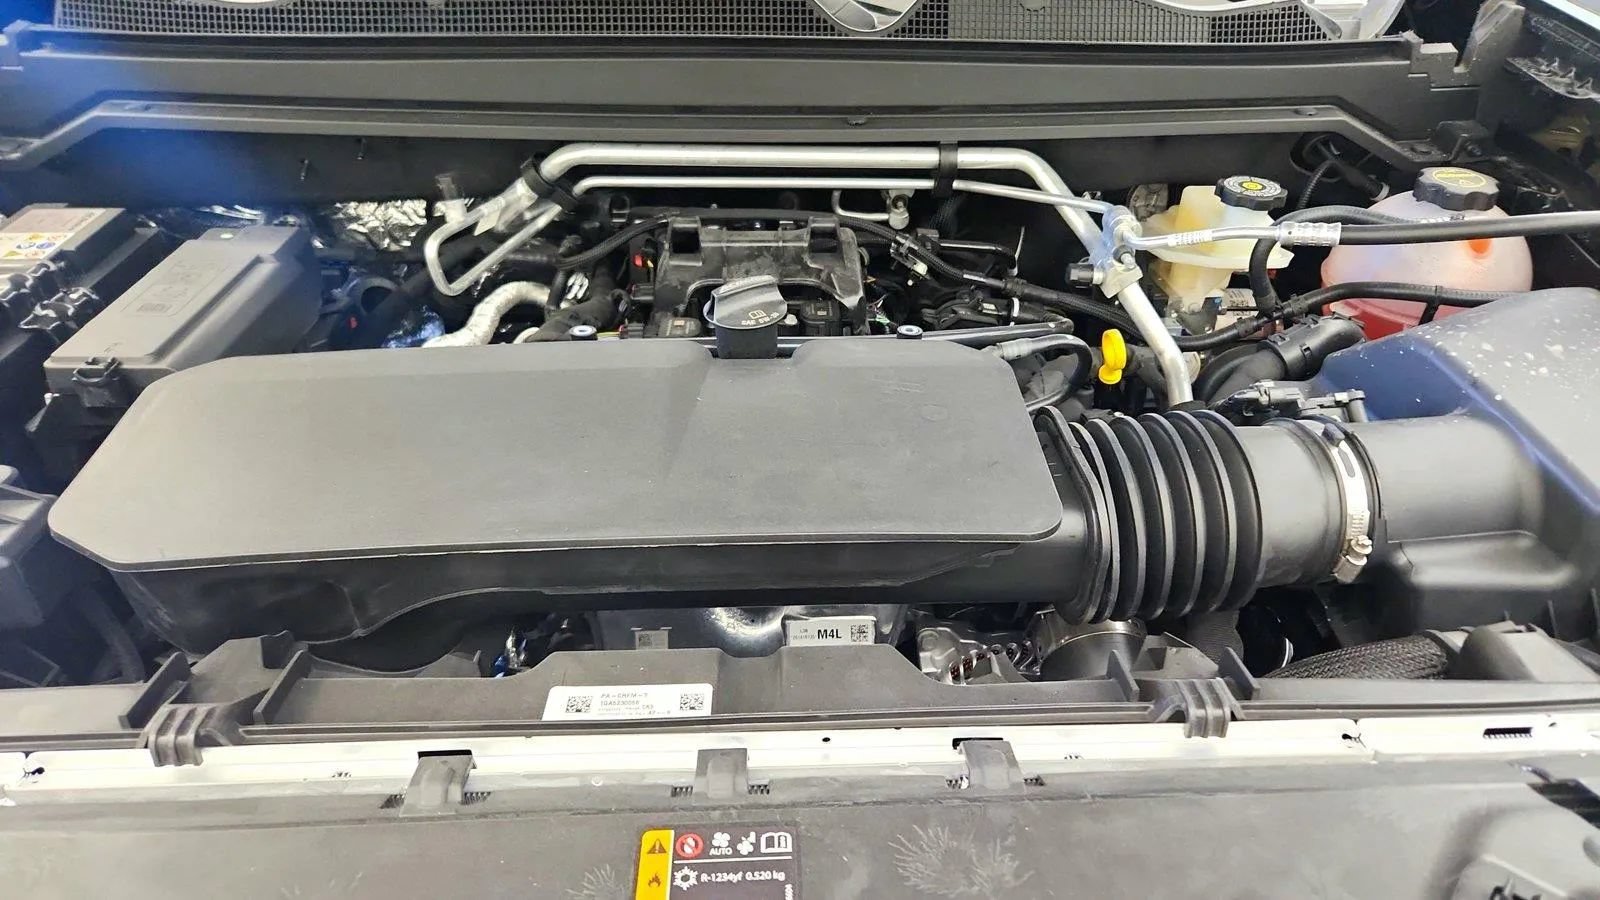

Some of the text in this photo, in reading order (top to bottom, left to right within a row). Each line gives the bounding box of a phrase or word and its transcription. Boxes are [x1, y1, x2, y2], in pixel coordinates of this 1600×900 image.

[817, 628, 842, 639] M4L
[709, 847, 732, 856] AUTO
[700, 869, 786, 883] R-1234yf 0.520 kg
